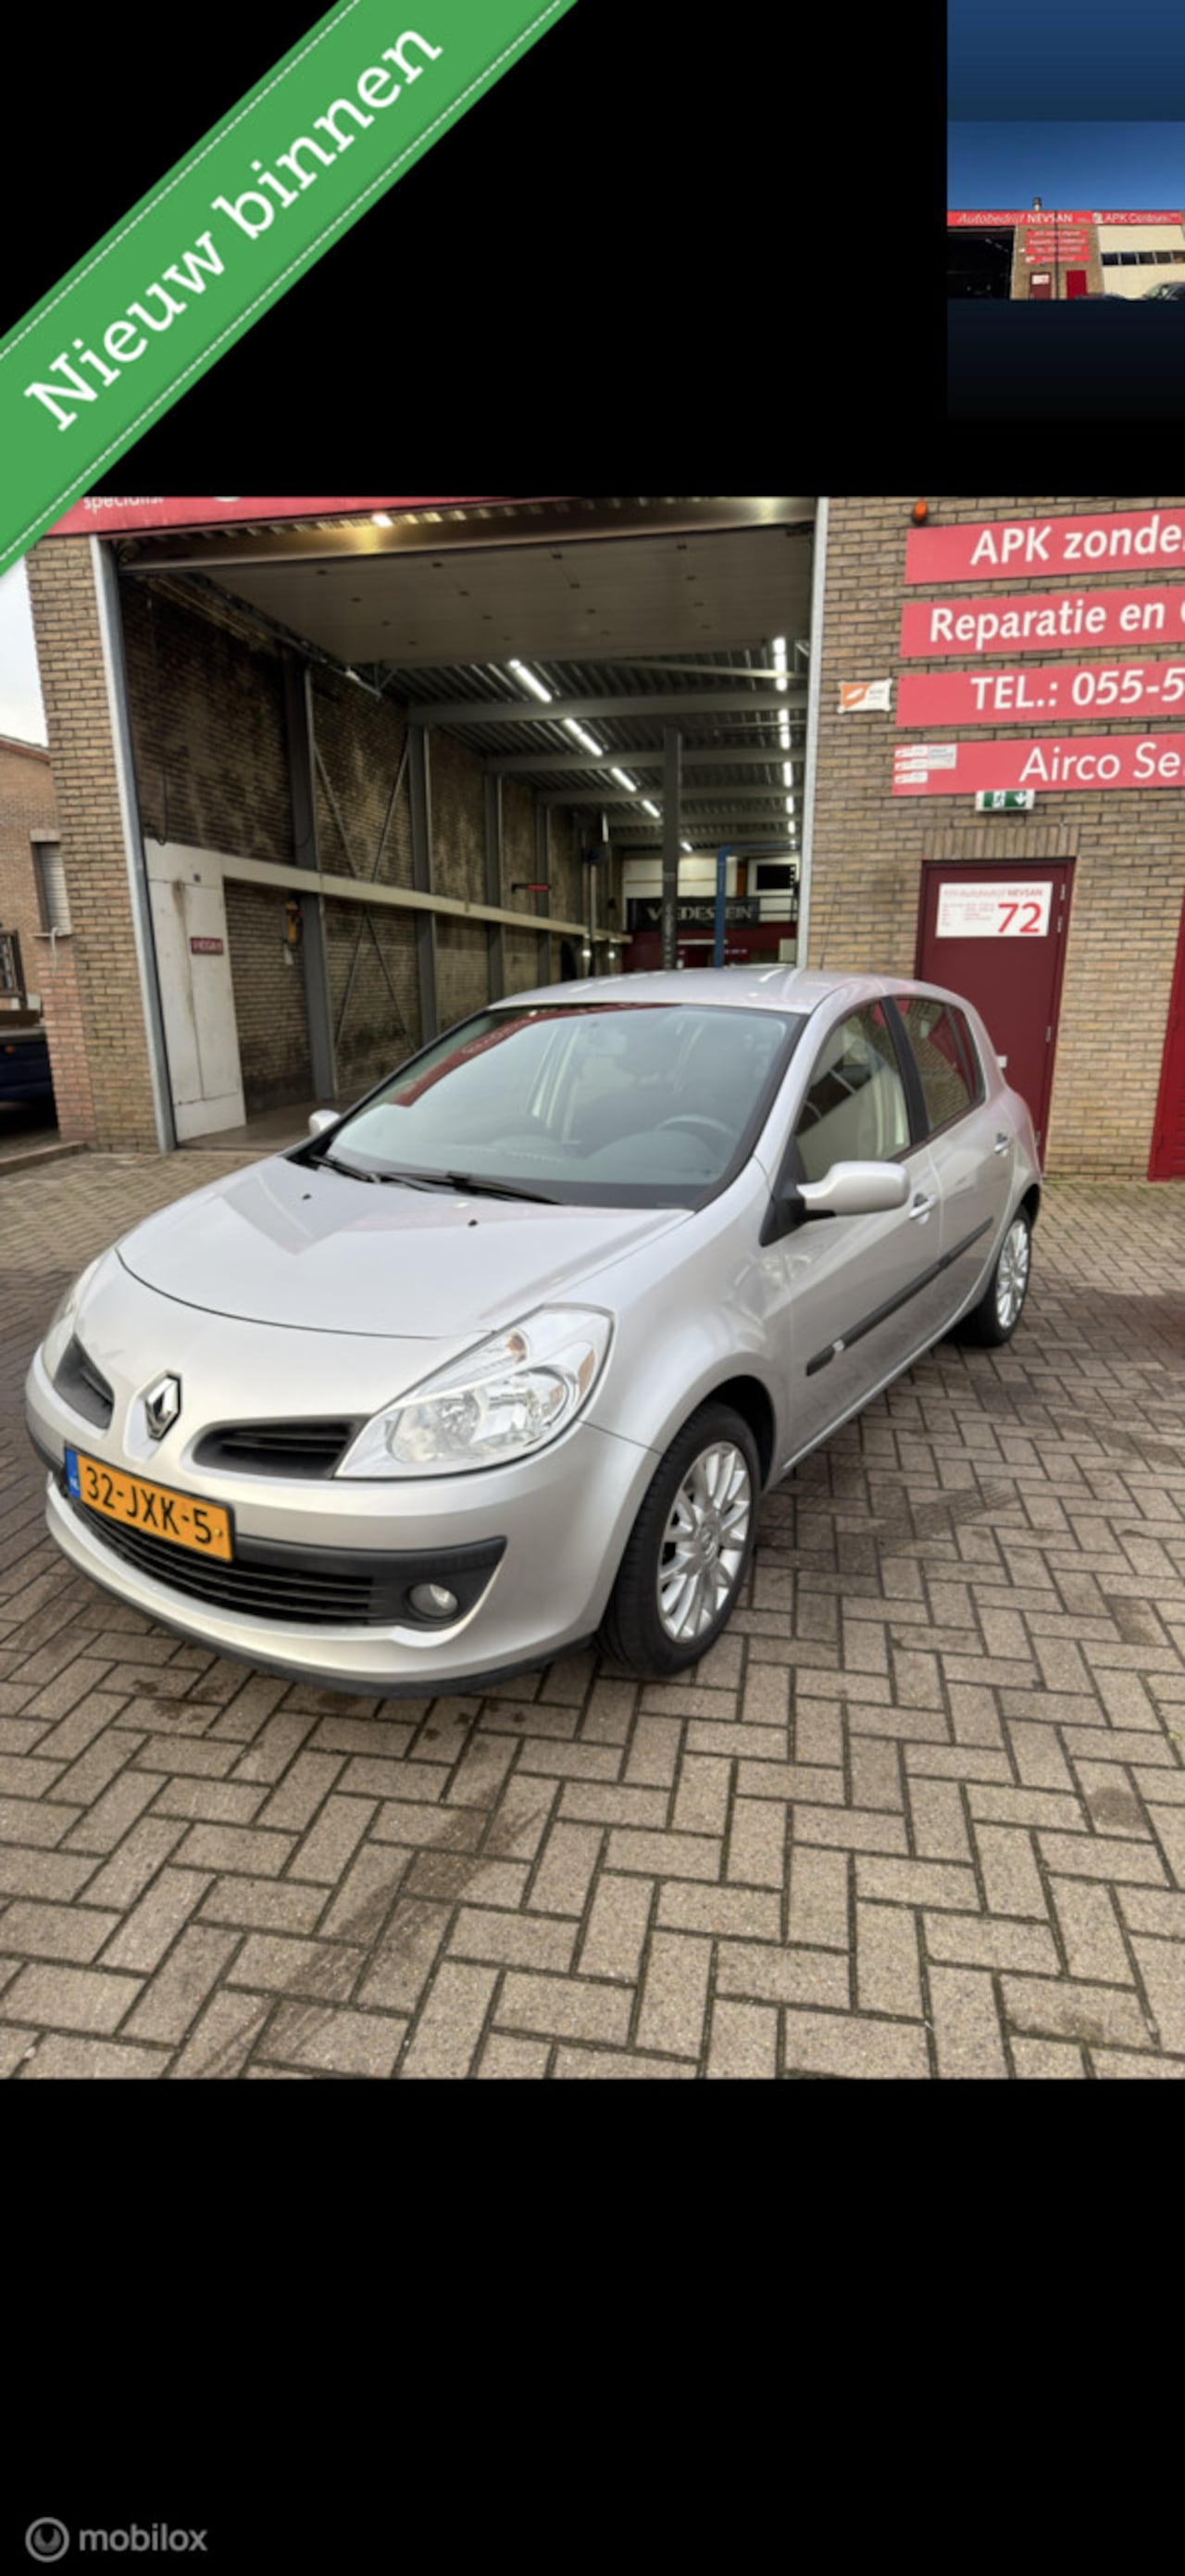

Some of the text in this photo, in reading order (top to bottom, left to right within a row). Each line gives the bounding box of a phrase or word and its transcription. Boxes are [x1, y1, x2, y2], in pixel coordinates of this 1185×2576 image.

[970, 515, 1185, 566] APK zonde
[930, 599, 1106, 651] Reparatie
[1119, 602, 1166, 631] en
[970, 668, 1185, 710] TEL.: 055-5
[1019, 742, 1185, 782] Airco Se
[647, 906, 752, 920] VEDESEIN
[997, 902, 1042, 933] 72
[86, 1466, 212, 1544] 32-JXK-5
